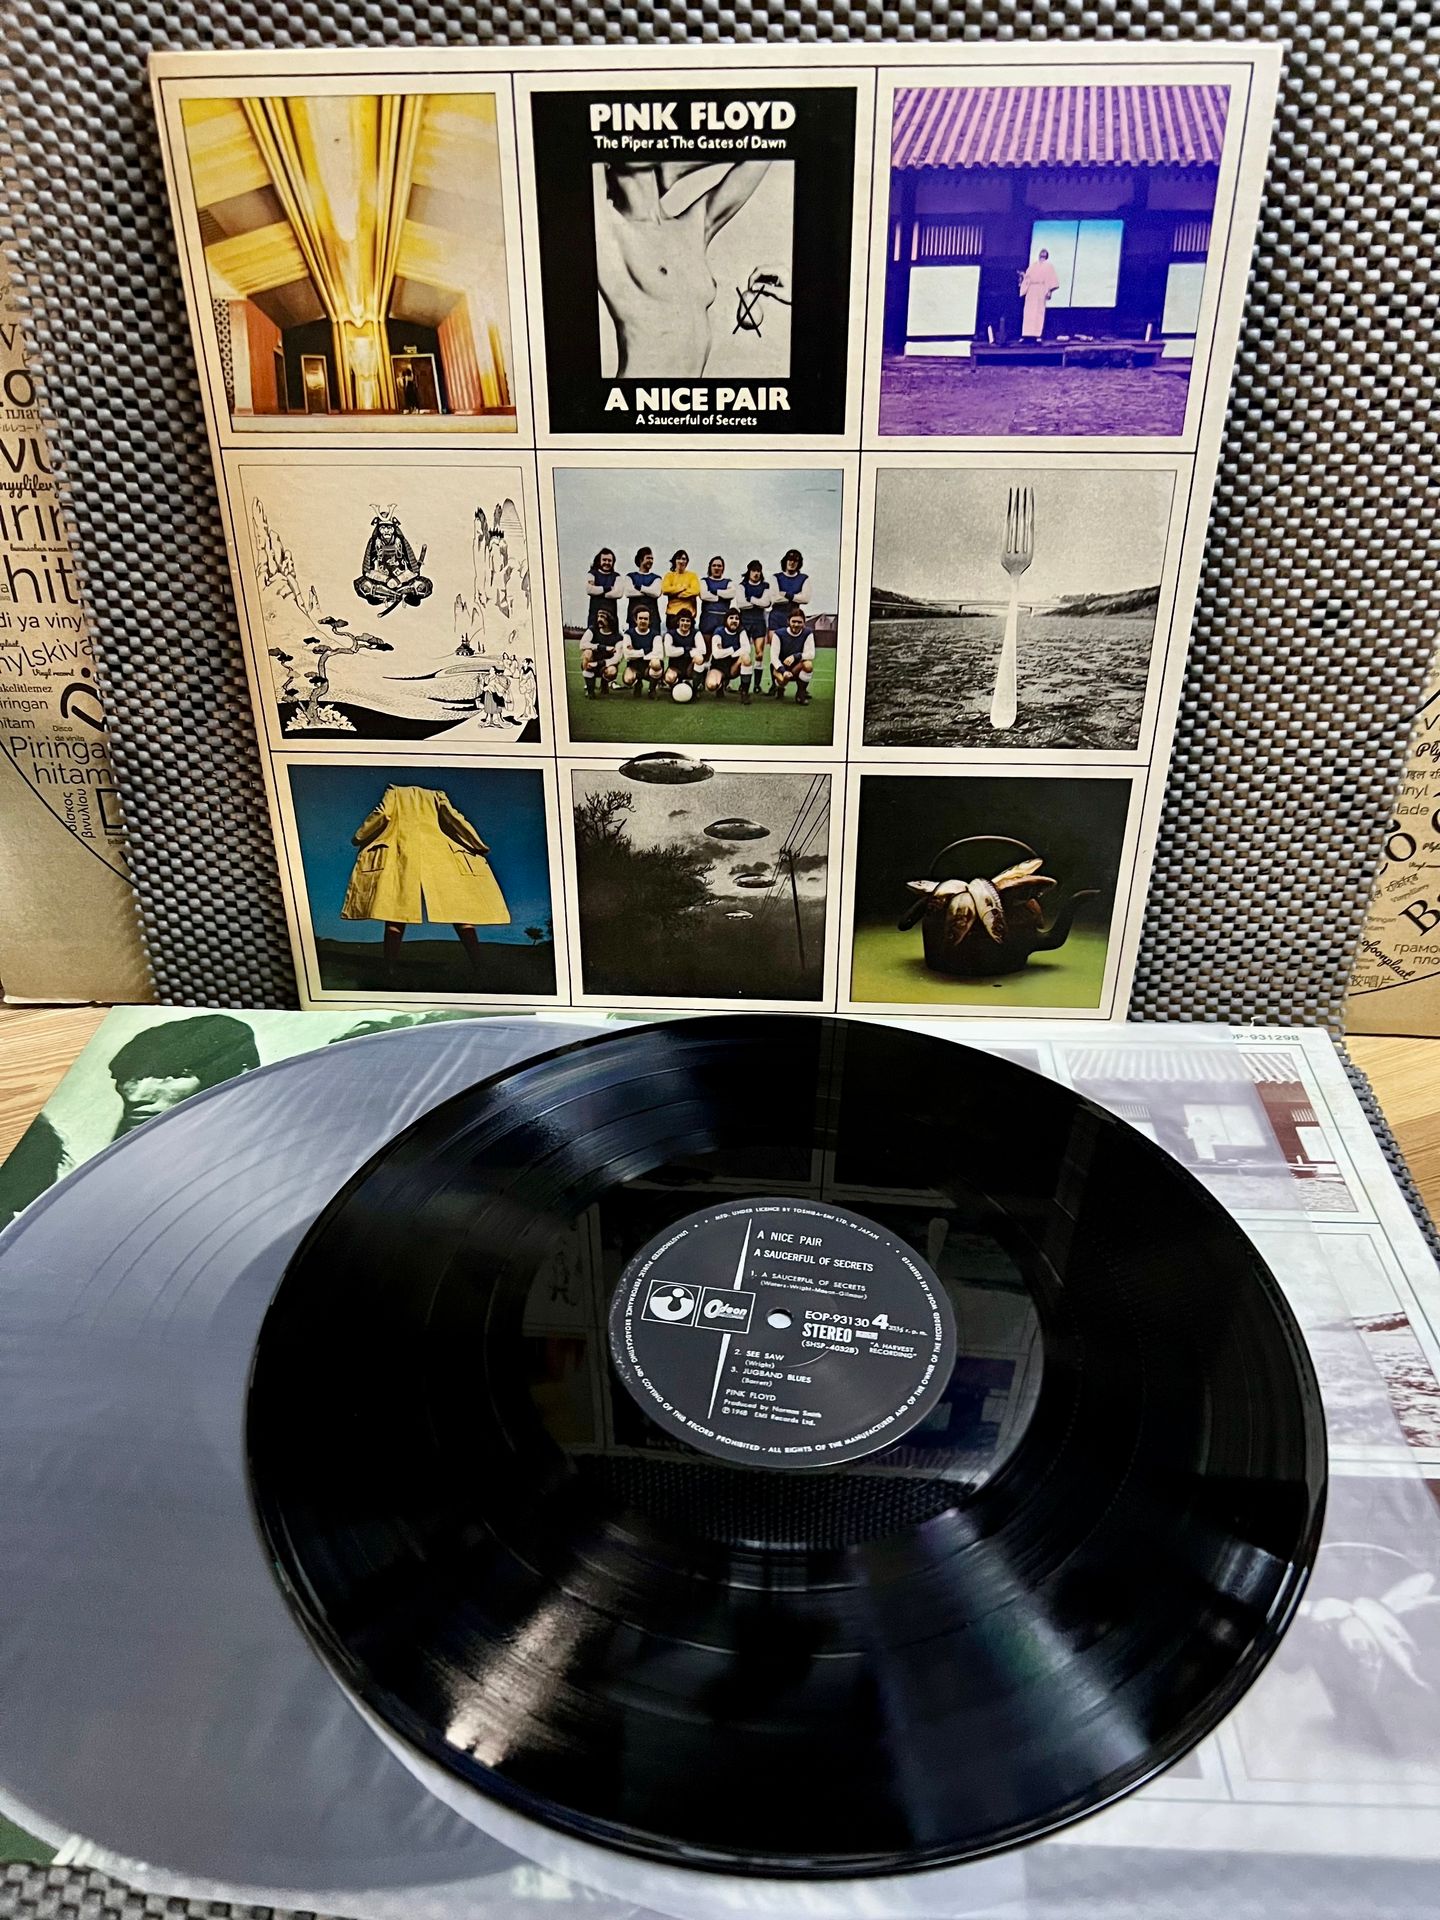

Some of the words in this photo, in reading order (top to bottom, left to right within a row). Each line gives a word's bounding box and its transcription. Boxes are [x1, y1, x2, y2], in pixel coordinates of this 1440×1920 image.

[590, 102, 678, 131] PINK
[690, 101, 796, 130] FLOYD
[593, 135, 618, 149] The
[621, 135, 654, 152] Piper
[656, 137, 669, 149] at
[670, 135, 695, 149] The
[697, 136, 733, 149] Gates
[735, 135, 749, 149] of
[751, 136, 786, 149] Dawn
[604, 387, 629, 411] A
[635, 387, 709, 411] NICE
[716, 387, 791, 411] PAIR
[635, 414, 646, 425] A
[648, 414, 700, 425] Saucerful
[702, 414, 714, 425] of
[716, 414, 757, 426] Secrets
[17, 616, 40, 632] ya
[757, 1230, 765, 1239] A
[770, 1231, 795, 1244] NICE
[799, 1235, 823, 1247] PAIR
[858, 1226, 880, 1240] JAPAN
[753, 1248, 761, 1257] A
[763, 1249, 816, 1264] SAUCERFUL
[819, 1256, 832, 1266] OF
[833, 1259, 874, 1272] SECRETS
[772, 1273, 814, 1285] SAUCERFUL
[833, 1281, 866, 1292] SECRETS
[871, 1313, 889, 1330] 4
[802, 1322, 852, 1343] STEREO
[746, 1350, 760, 1358] SEE
[764, 1352, 784, 1361] SAW
[882, 1343, 914, 1353] HARVEST
[742, 1368, 783, 1379] JUGBAND
[787, 1374, 812, 1384] BLUES
[725, 1388, 746, 1398] PINK
[749, 1391, 777, 1402] FLOYD
[723, 1399, 757, 1409] Produced
[662, 1402, 673, 1412] OF
[686, 1420, 714, 1437] RECORD
[715, 1434, 760, 1451] PROHIBITED
[784, 1445, 813, 1453] RIGHTS
[828, 1440, 843, 1449] THE
[844, 1415, 895, 1445] MANUFACTURER
[894, 1404, 909, 1417] AND
[906, 1395, 916, 1405] OF
